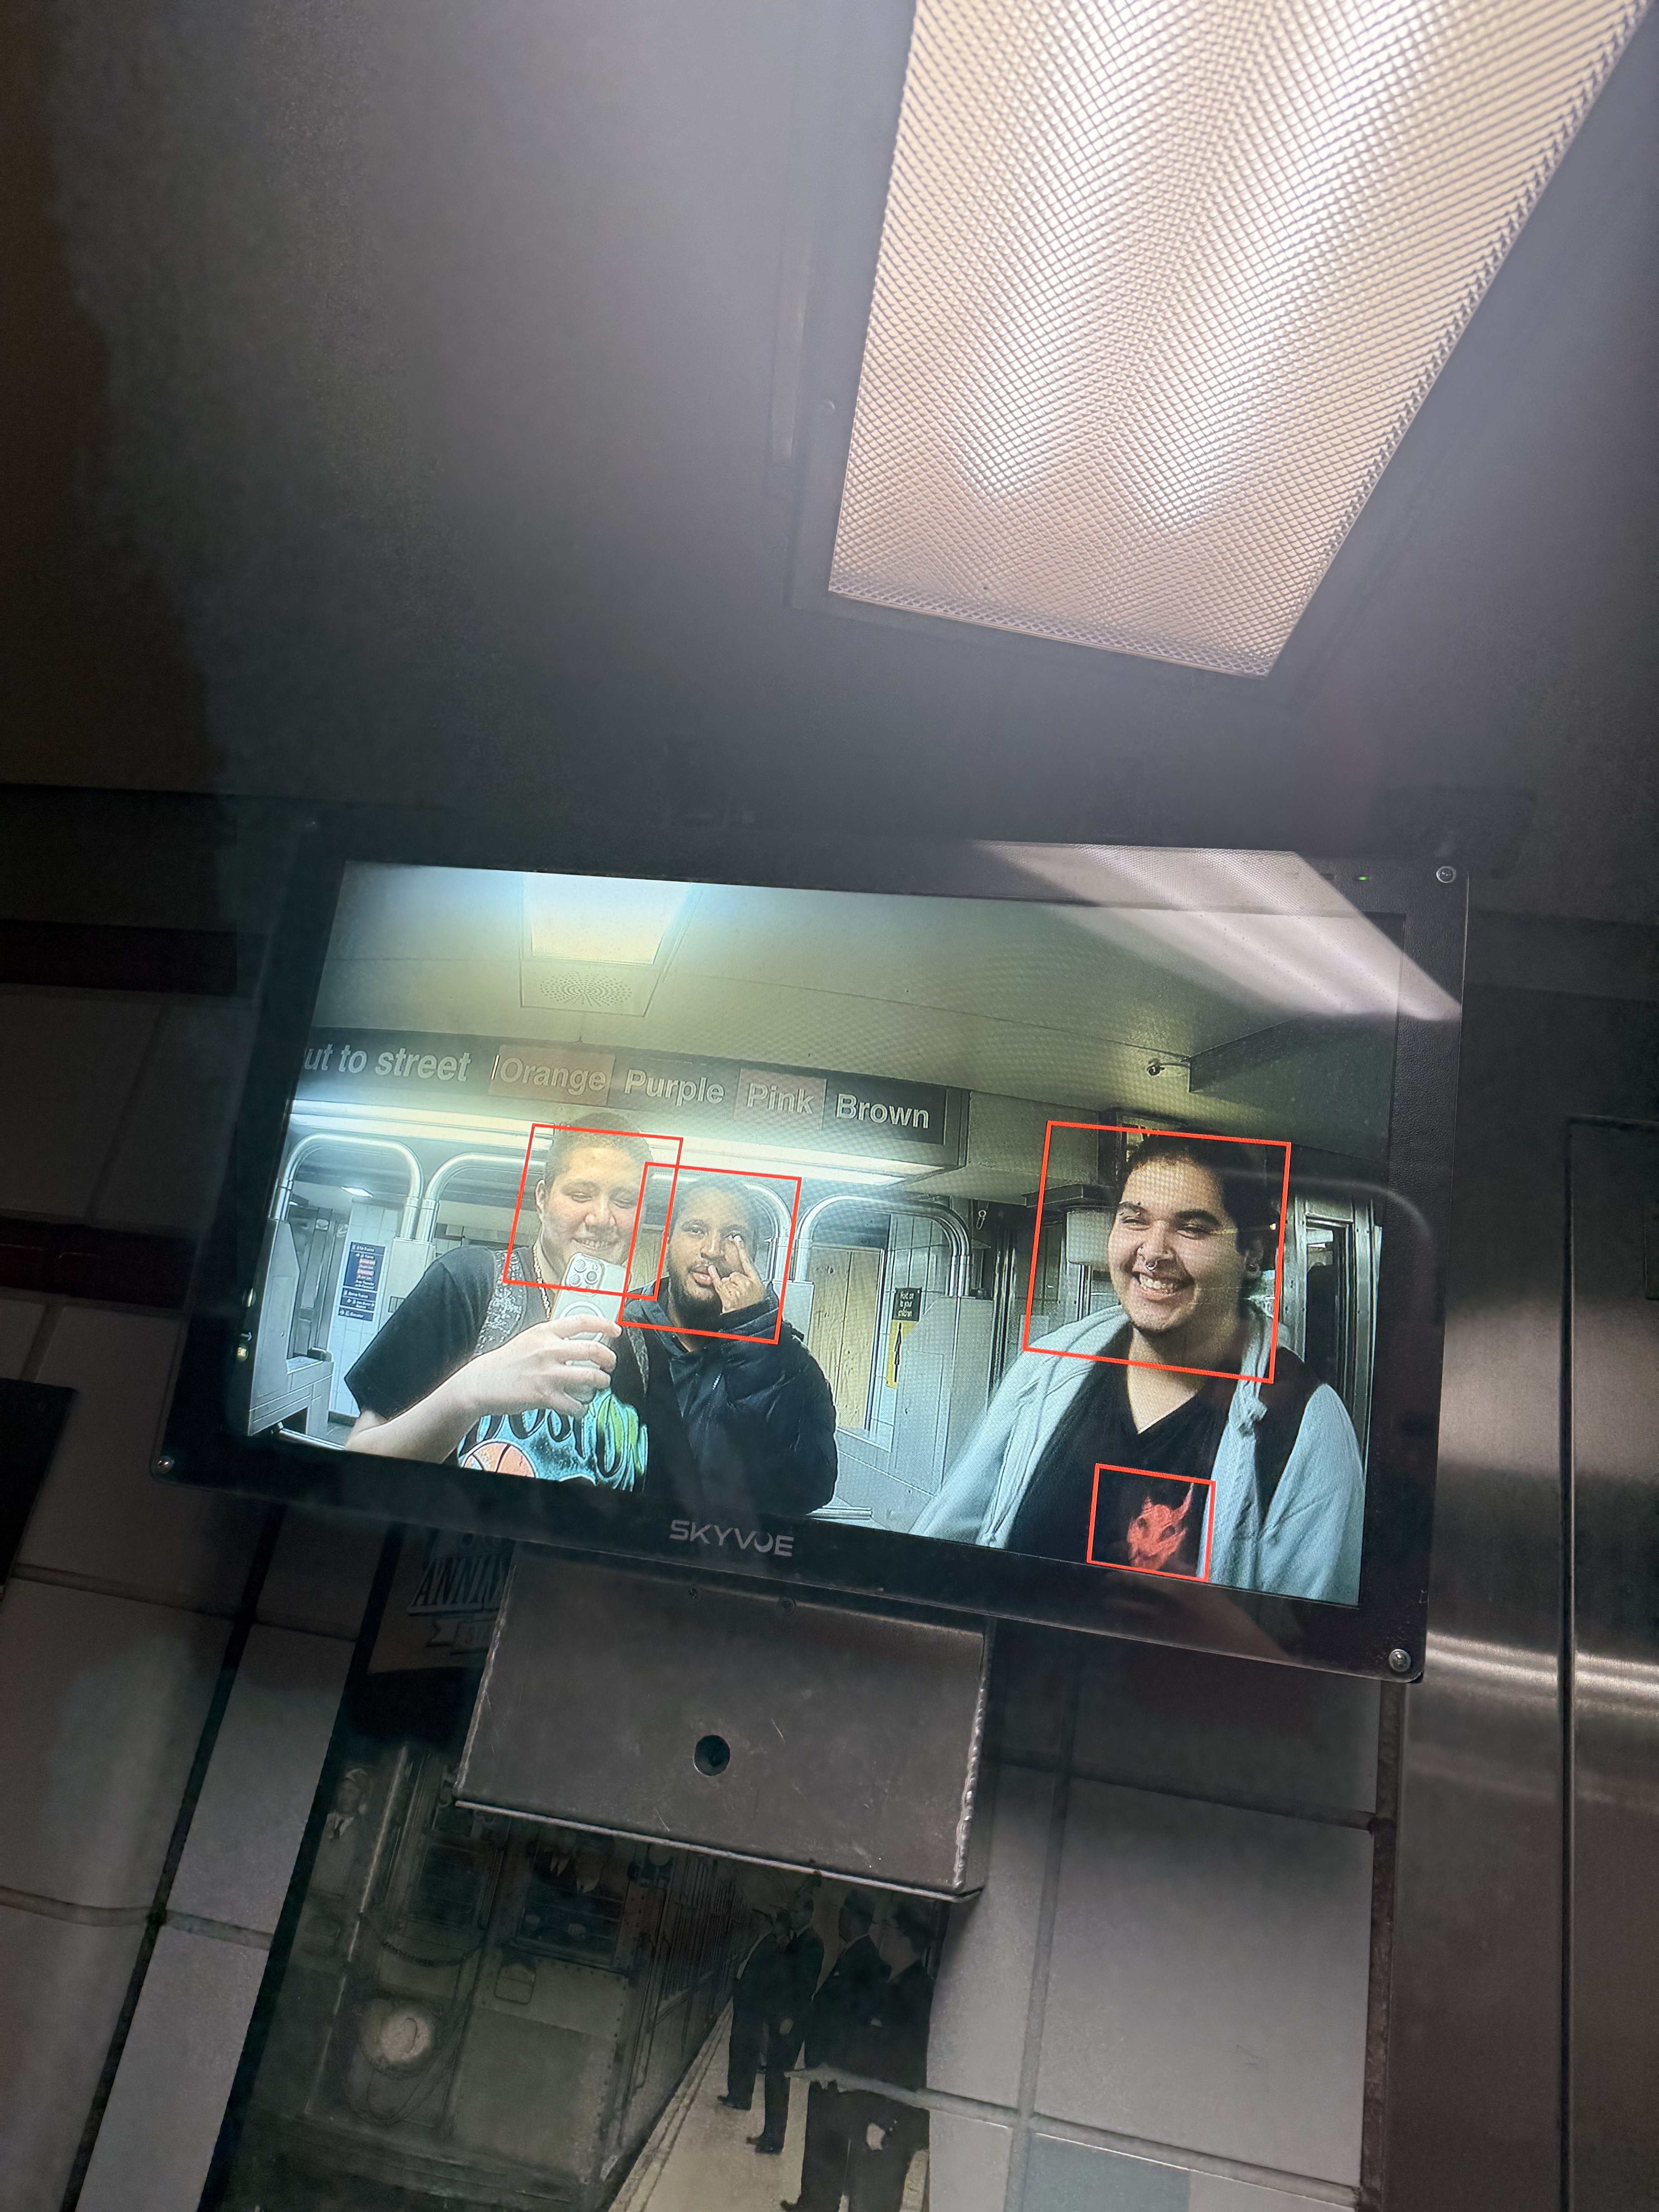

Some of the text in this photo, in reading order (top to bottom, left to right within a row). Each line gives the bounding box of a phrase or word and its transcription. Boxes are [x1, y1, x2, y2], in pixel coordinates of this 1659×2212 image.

[304, 1044, 929, 1128] ut to street Orange Purple Pink Brown
